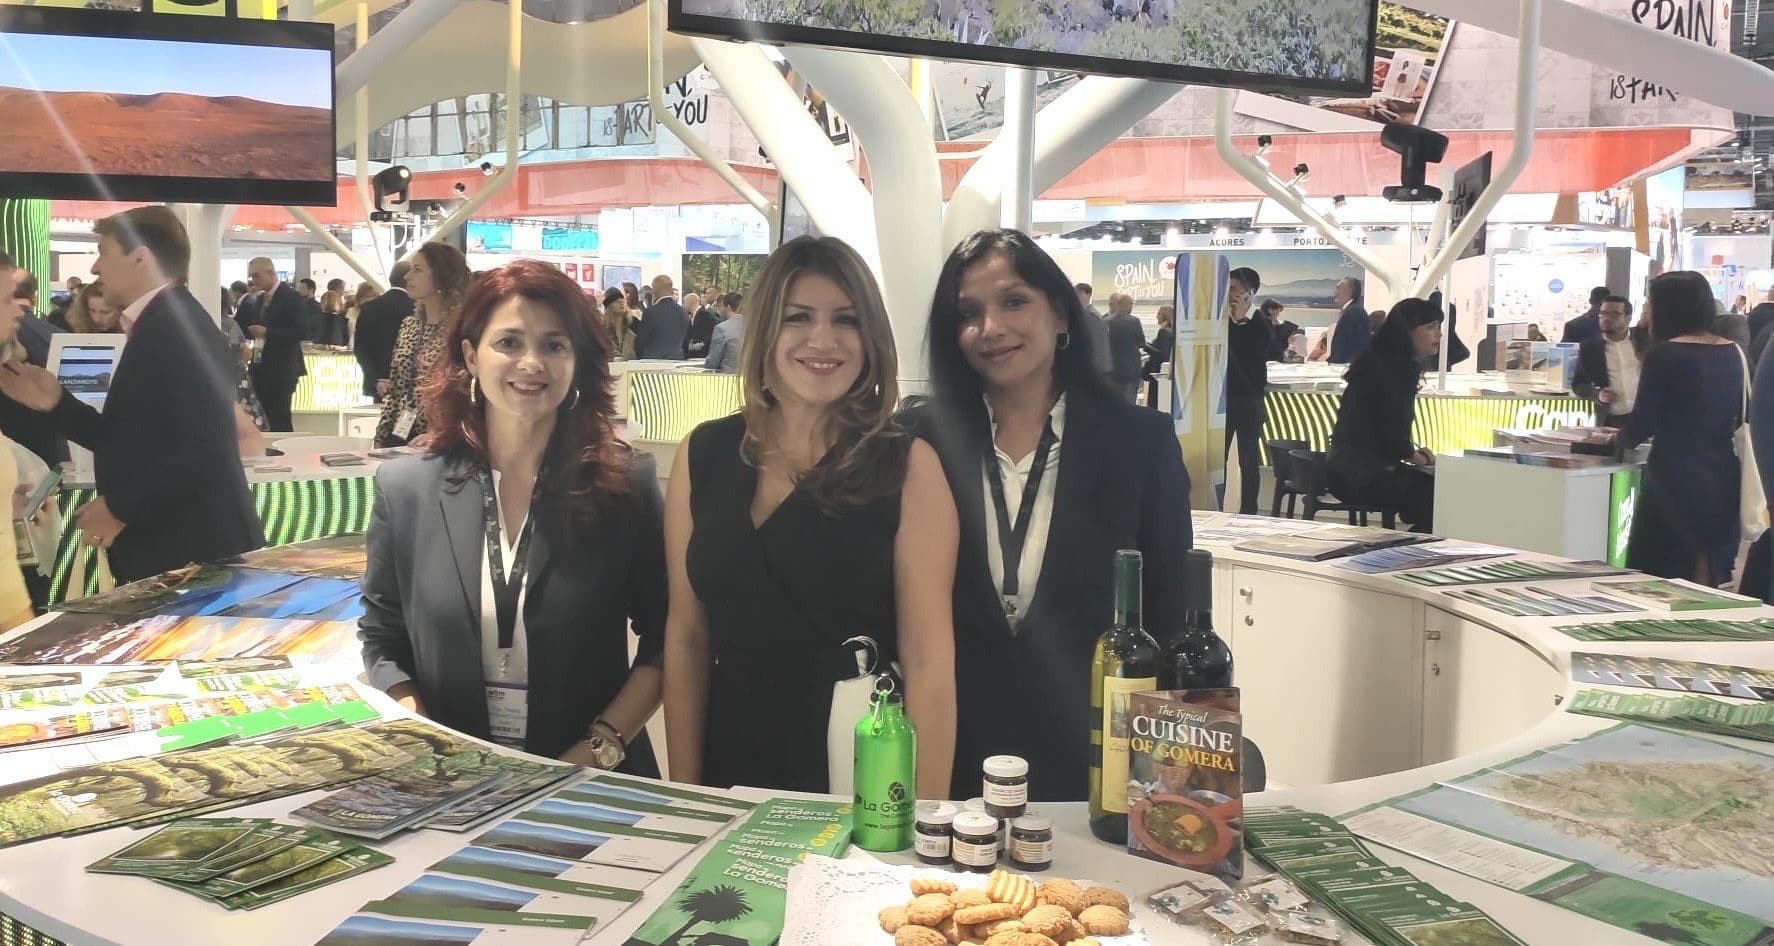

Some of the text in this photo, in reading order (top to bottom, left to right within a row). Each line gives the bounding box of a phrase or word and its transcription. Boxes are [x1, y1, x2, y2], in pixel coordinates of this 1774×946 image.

[673, 93, 708, 126] YOU
[1158, 704, 1208, 724] The Typical
[1132, 715, 1234, 753] CUISINE
[1131, 737, 1236, 772] OF GOMERA
[863, 799, 877, 812] La
[785, 814, 839, 822] Gomera
[739, 837, 805, 850] senderos
[726, 848, 792, 864] senderos
[723, 868, 787, 890] La Gome
[730, 863, 788, 883] sendero
